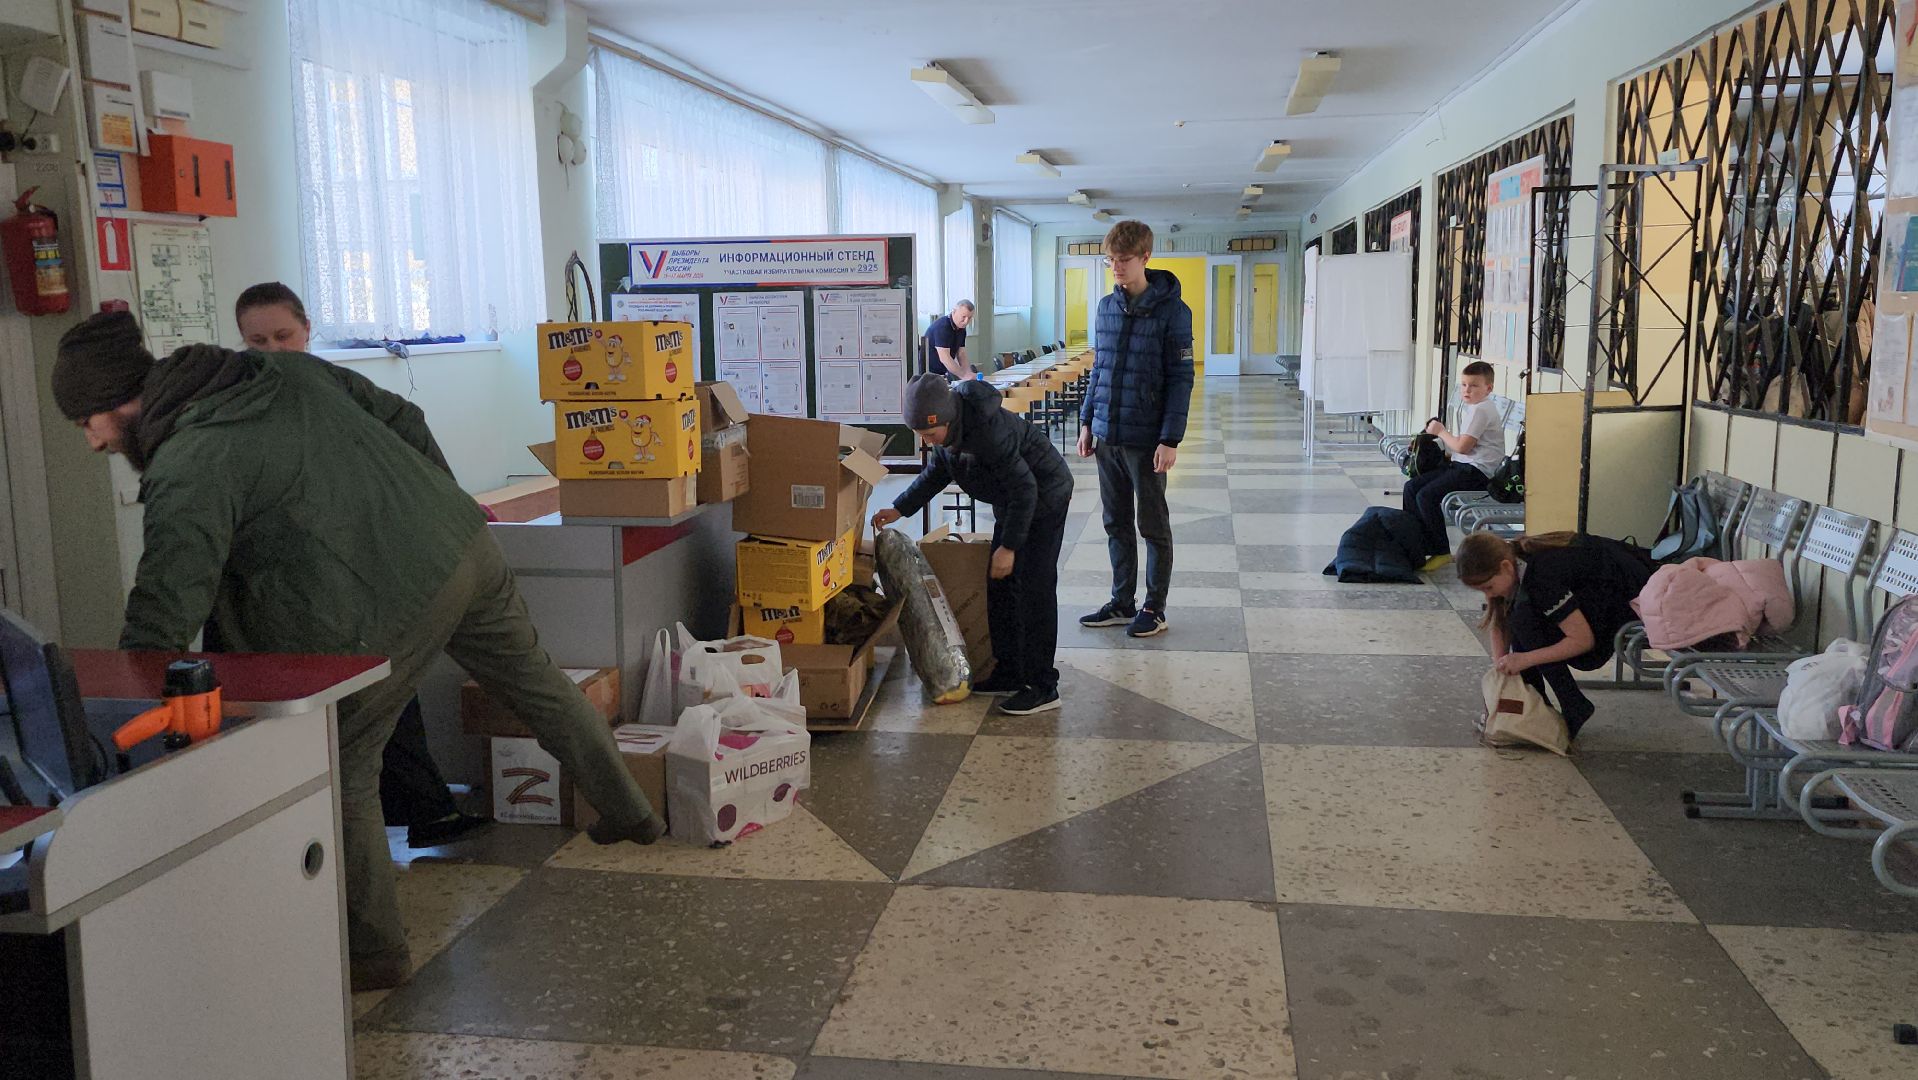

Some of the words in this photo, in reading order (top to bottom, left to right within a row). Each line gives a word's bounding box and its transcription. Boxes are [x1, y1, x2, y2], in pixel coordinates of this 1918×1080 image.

[668, 257, 710, 265] ПРЕЗИДЕНТА
[719, 249, 834, 264] ИНФОРМАЦИОННЫЙ
[837, 250, 875, 263] СТЕНД
[857, 264, 879, 273] 2925
[724, 750, 806, 784] WILDBERRIES
